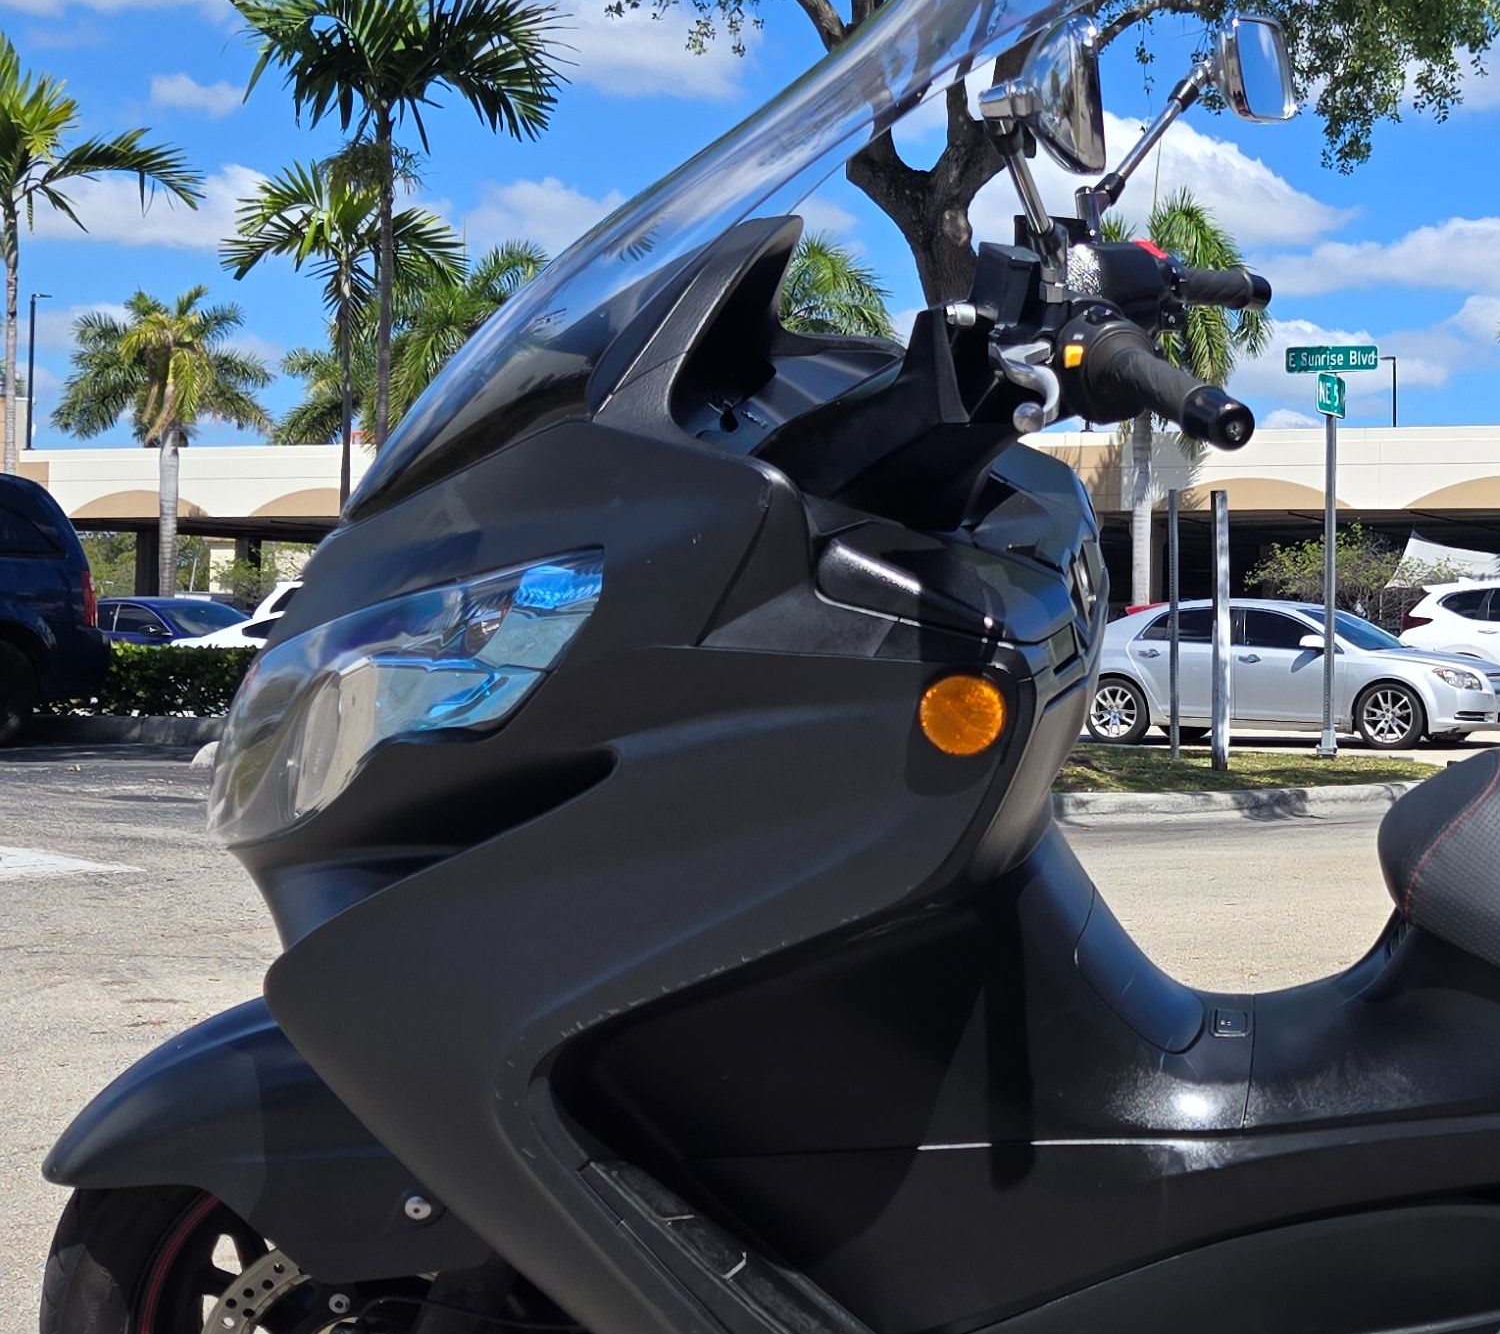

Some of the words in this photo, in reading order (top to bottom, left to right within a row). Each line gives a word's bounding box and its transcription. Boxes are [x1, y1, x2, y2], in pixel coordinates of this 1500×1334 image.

[1289, 353, 1296, 367] E
[1301, 351, 1344, 366] Sunrise
[1349, 350, 1375, 366] Blvd
[1319, 380, 1331, 404] NE
